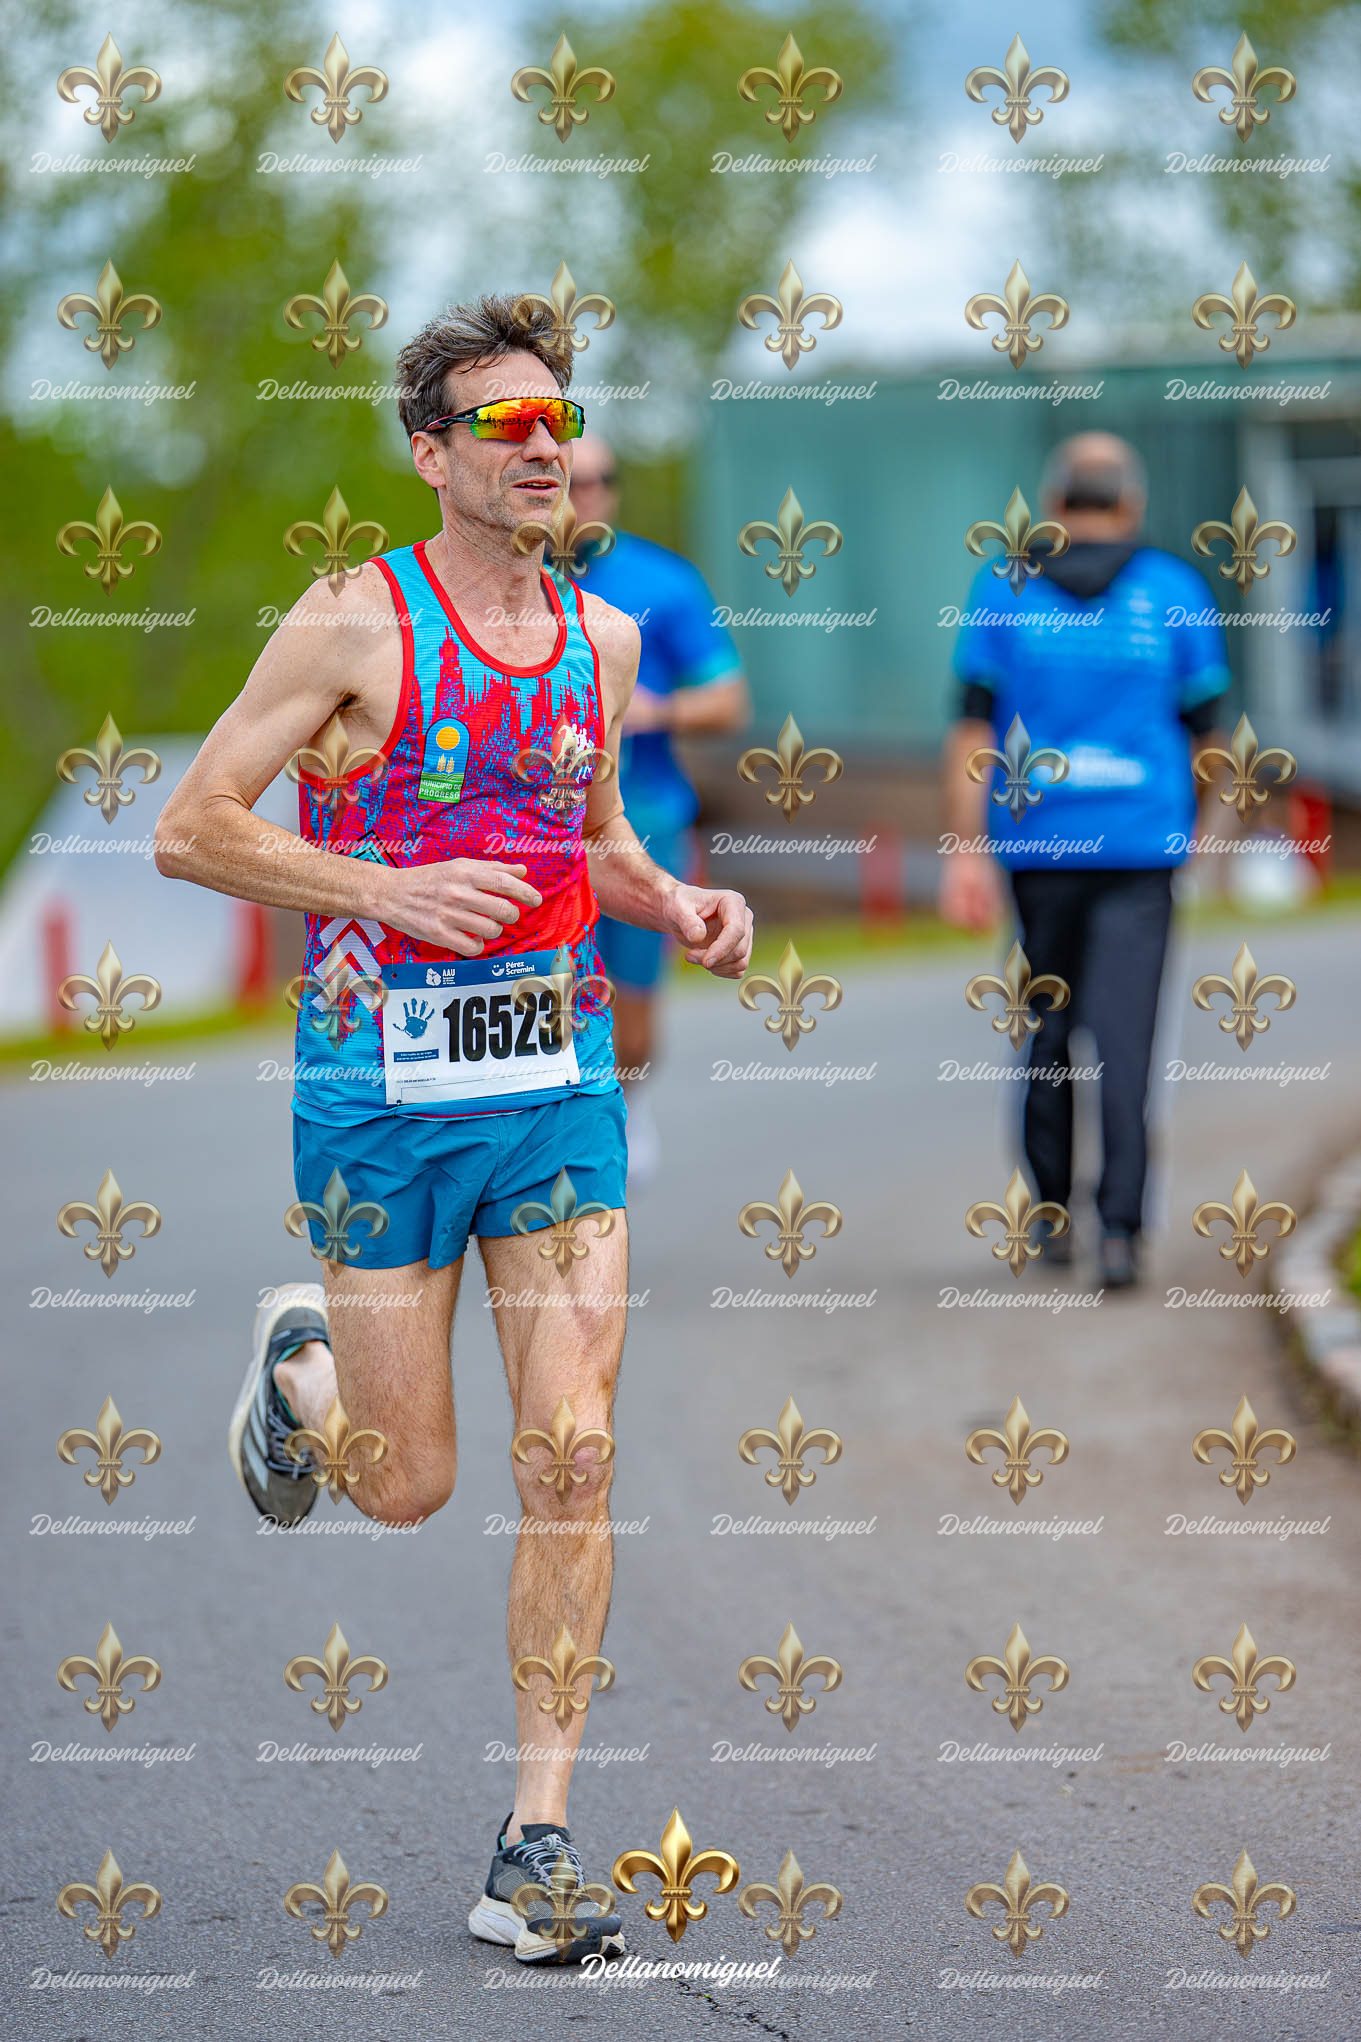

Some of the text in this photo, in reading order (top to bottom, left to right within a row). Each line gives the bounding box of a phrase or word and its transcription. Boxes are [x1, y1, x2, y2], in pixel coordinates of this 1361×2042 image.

[418, 787, 461, 799] PROGRESO
[505, 961, 525, 969] Pérez
[442, 989, 563, 1063] 16523
